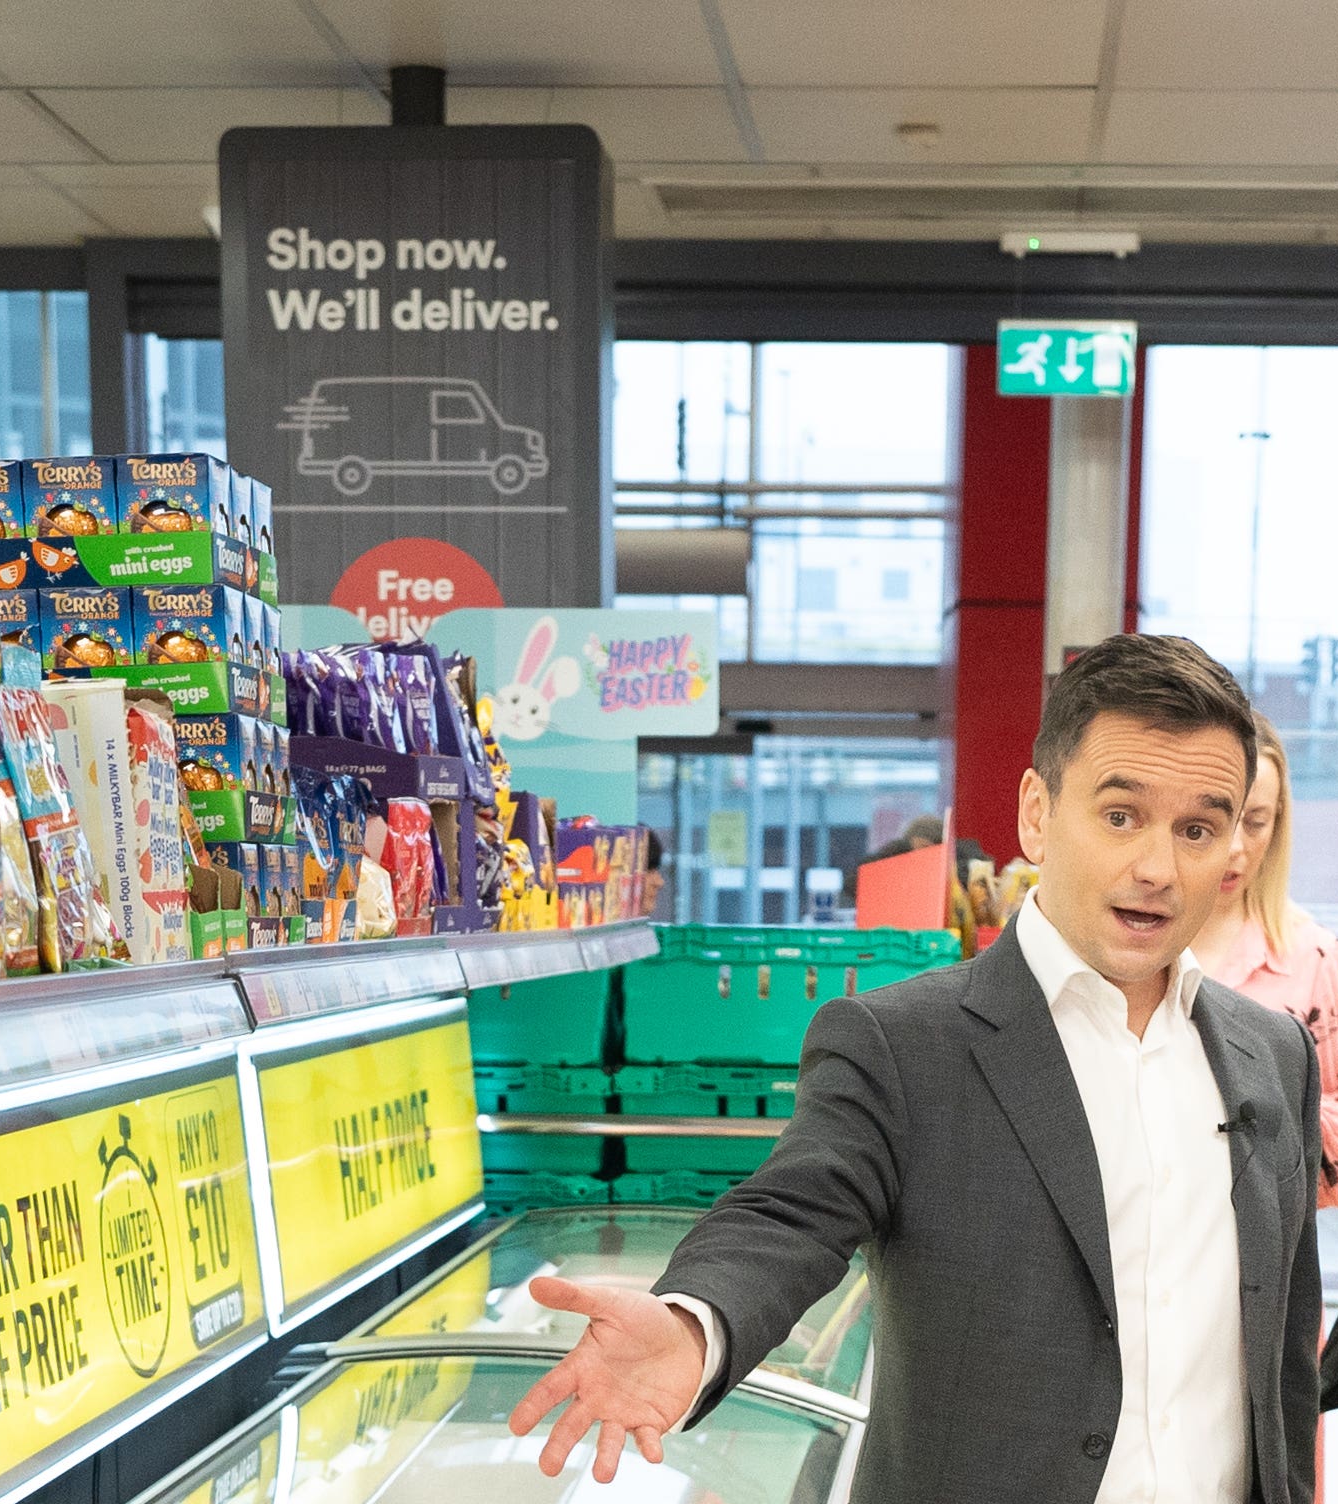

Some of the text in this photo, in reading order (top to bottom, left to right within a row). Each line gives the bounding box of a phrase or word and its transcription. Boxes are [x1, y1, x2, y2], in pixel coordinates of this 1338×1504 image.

[266, 227, 508, 280] Shop now.
[266, 287, 560, 331] We'll deliver.
[33, 460, 103, 485] TERRY'S
[127, 457, 197, 480] TERRY'S
[158, 476, 197, 487] ORANGE
[63, 480, 103, 490] ORANGE
[109, 554, 193, 578] mini eggs
[377, 569, 455, 601] Free
[50, 591, 120, 613] TERRY'S
[143, 588, 213, 610] TERRY'S
[174, 606, 213, 617] ORANGE
[80, 609, 120, 620] ORANGE
[607, 633, 689, 677] HAPPY
[166, 685, 209, 705] eggs
[599, 671, 691, 709] EASTER
[104, 738, 115, 751] 14
[108, 763, 123, 820] MILKYBAR
[115, 821, 125, 845] Mini
[196, 813, 226, 833] ggs
[115, 847, 127, 873] Eggs
[119, 876, 131, 902] 100g
[123, 904, 135, 939] Blocks
[176, 1109, 220, 1174] ANY 10
[334, 1088, 437, 1222] HALF PRICE
[17, 1180, 86, 1285] THAN
[108, 1206, 155, 1261] LIMITED
[184, 1171, 230, 1283] £10
[114, 1251, 164, 1331] TIME
[13, 1285, 89, 1399] PRICE
